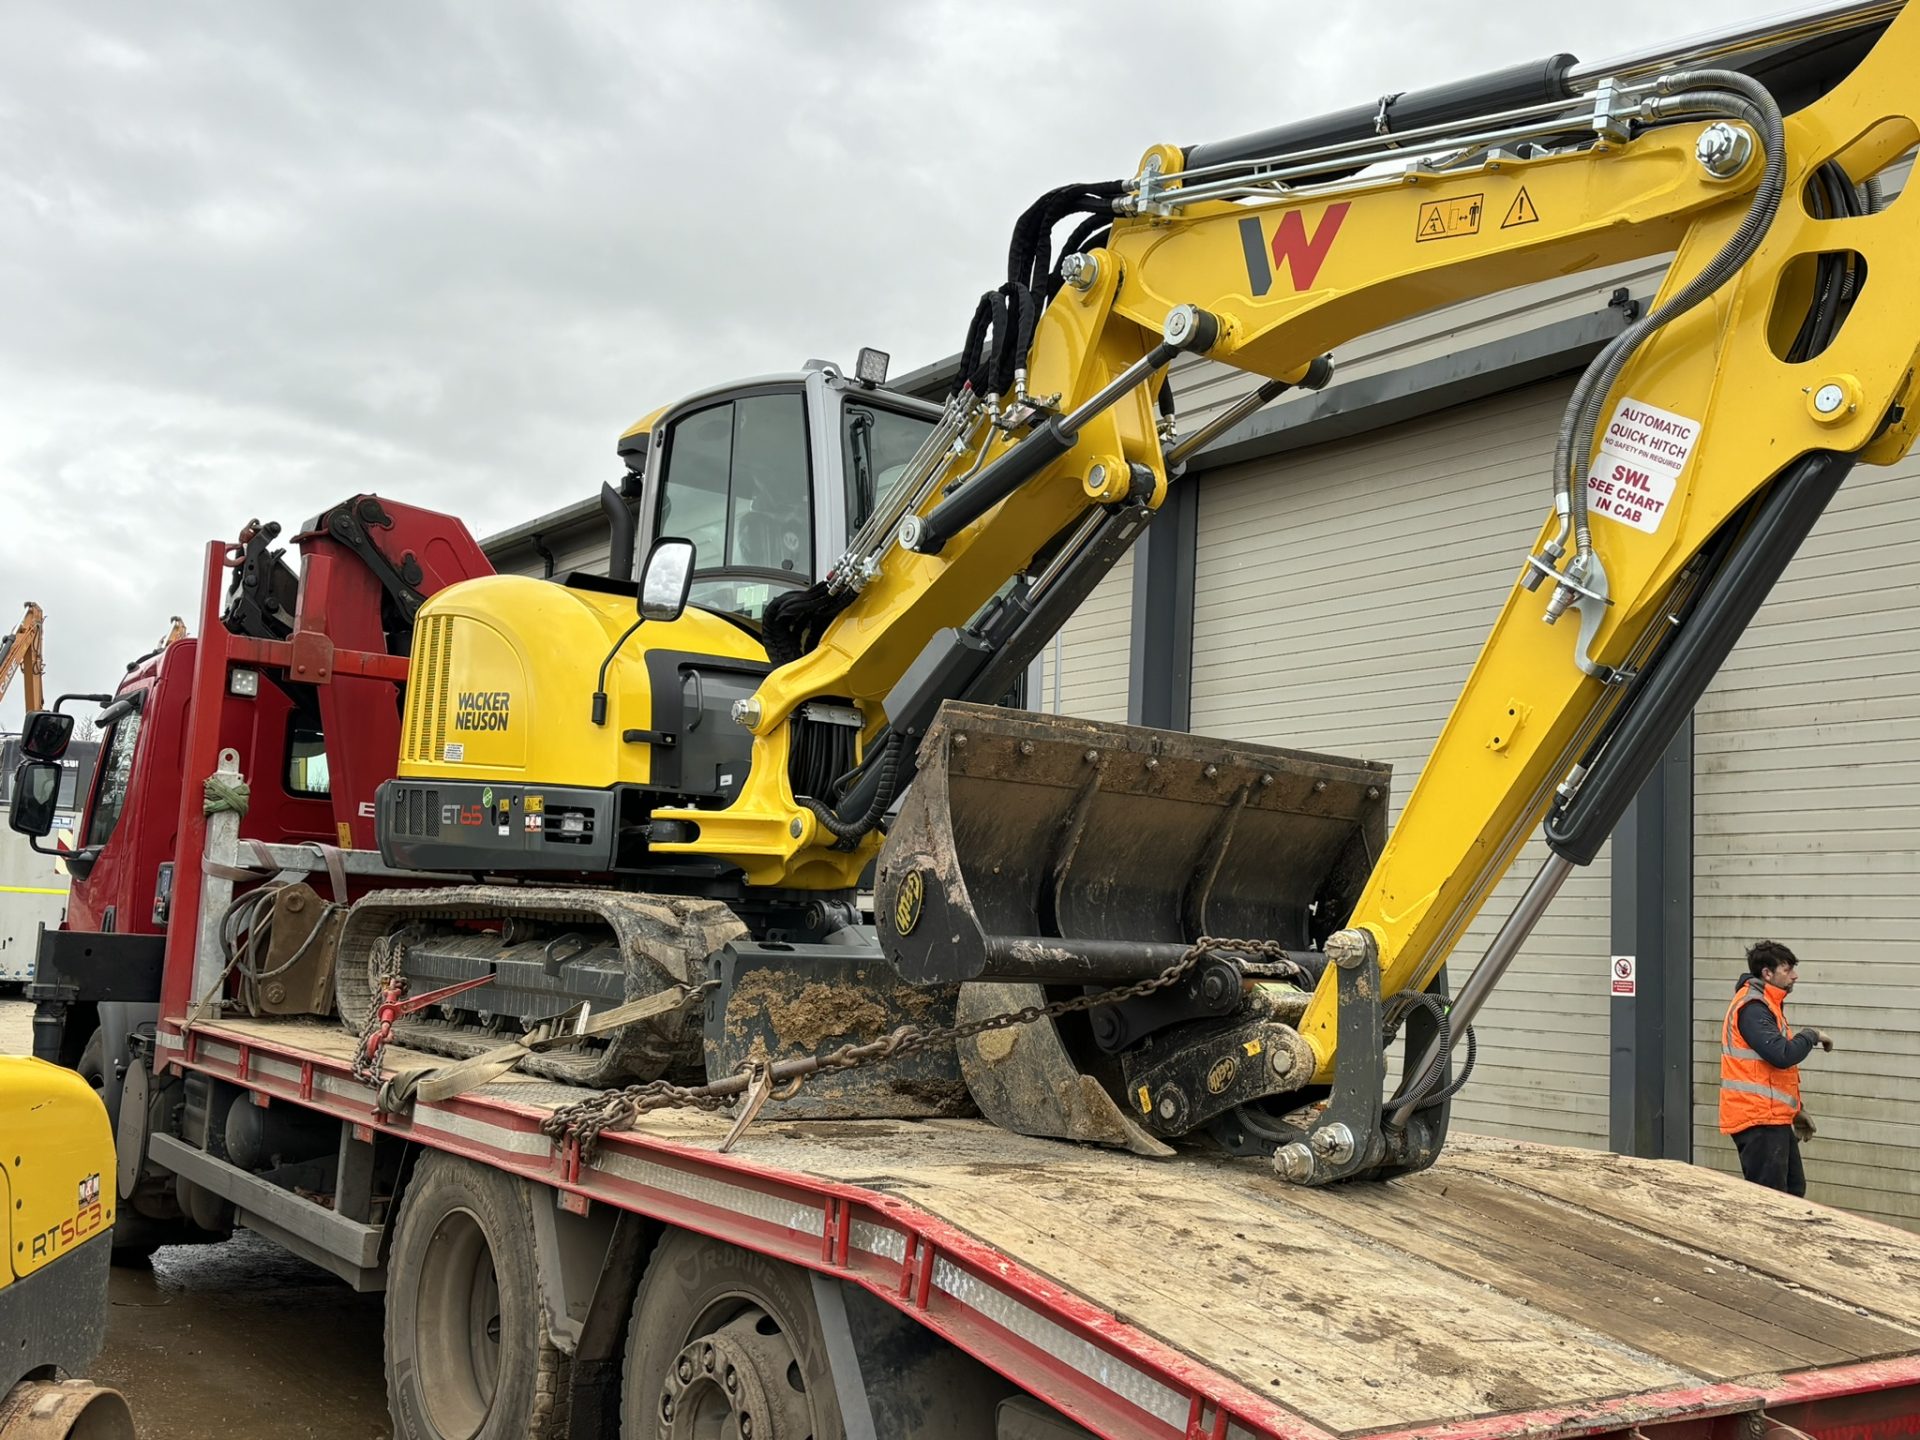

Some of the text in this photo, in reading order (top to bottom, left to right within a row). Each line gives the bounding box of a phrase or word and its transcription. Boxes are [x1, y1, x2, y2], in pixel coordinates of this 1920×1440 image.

[1620, 407, 1691, 440] AUTOMATIC
[1604, 436, 1682, 470] NO SAFETY PIN REQUIRED
[1610, 423, 1688, 460] QUICK HITCH
[1588, 477, 1664, 513] SEE CHART
[1612, 465, 1651, 492] SWL
[1595, 496, 1642, 523] IN CAB
[0, 658, 19, 694] CASE
[458, 691, 510, 711] WACKER
[455, 711, 509, 731] NEUSON
[441, 804, 483, 827] ET65
[32, 1202, 102, 1262] RTSC3
